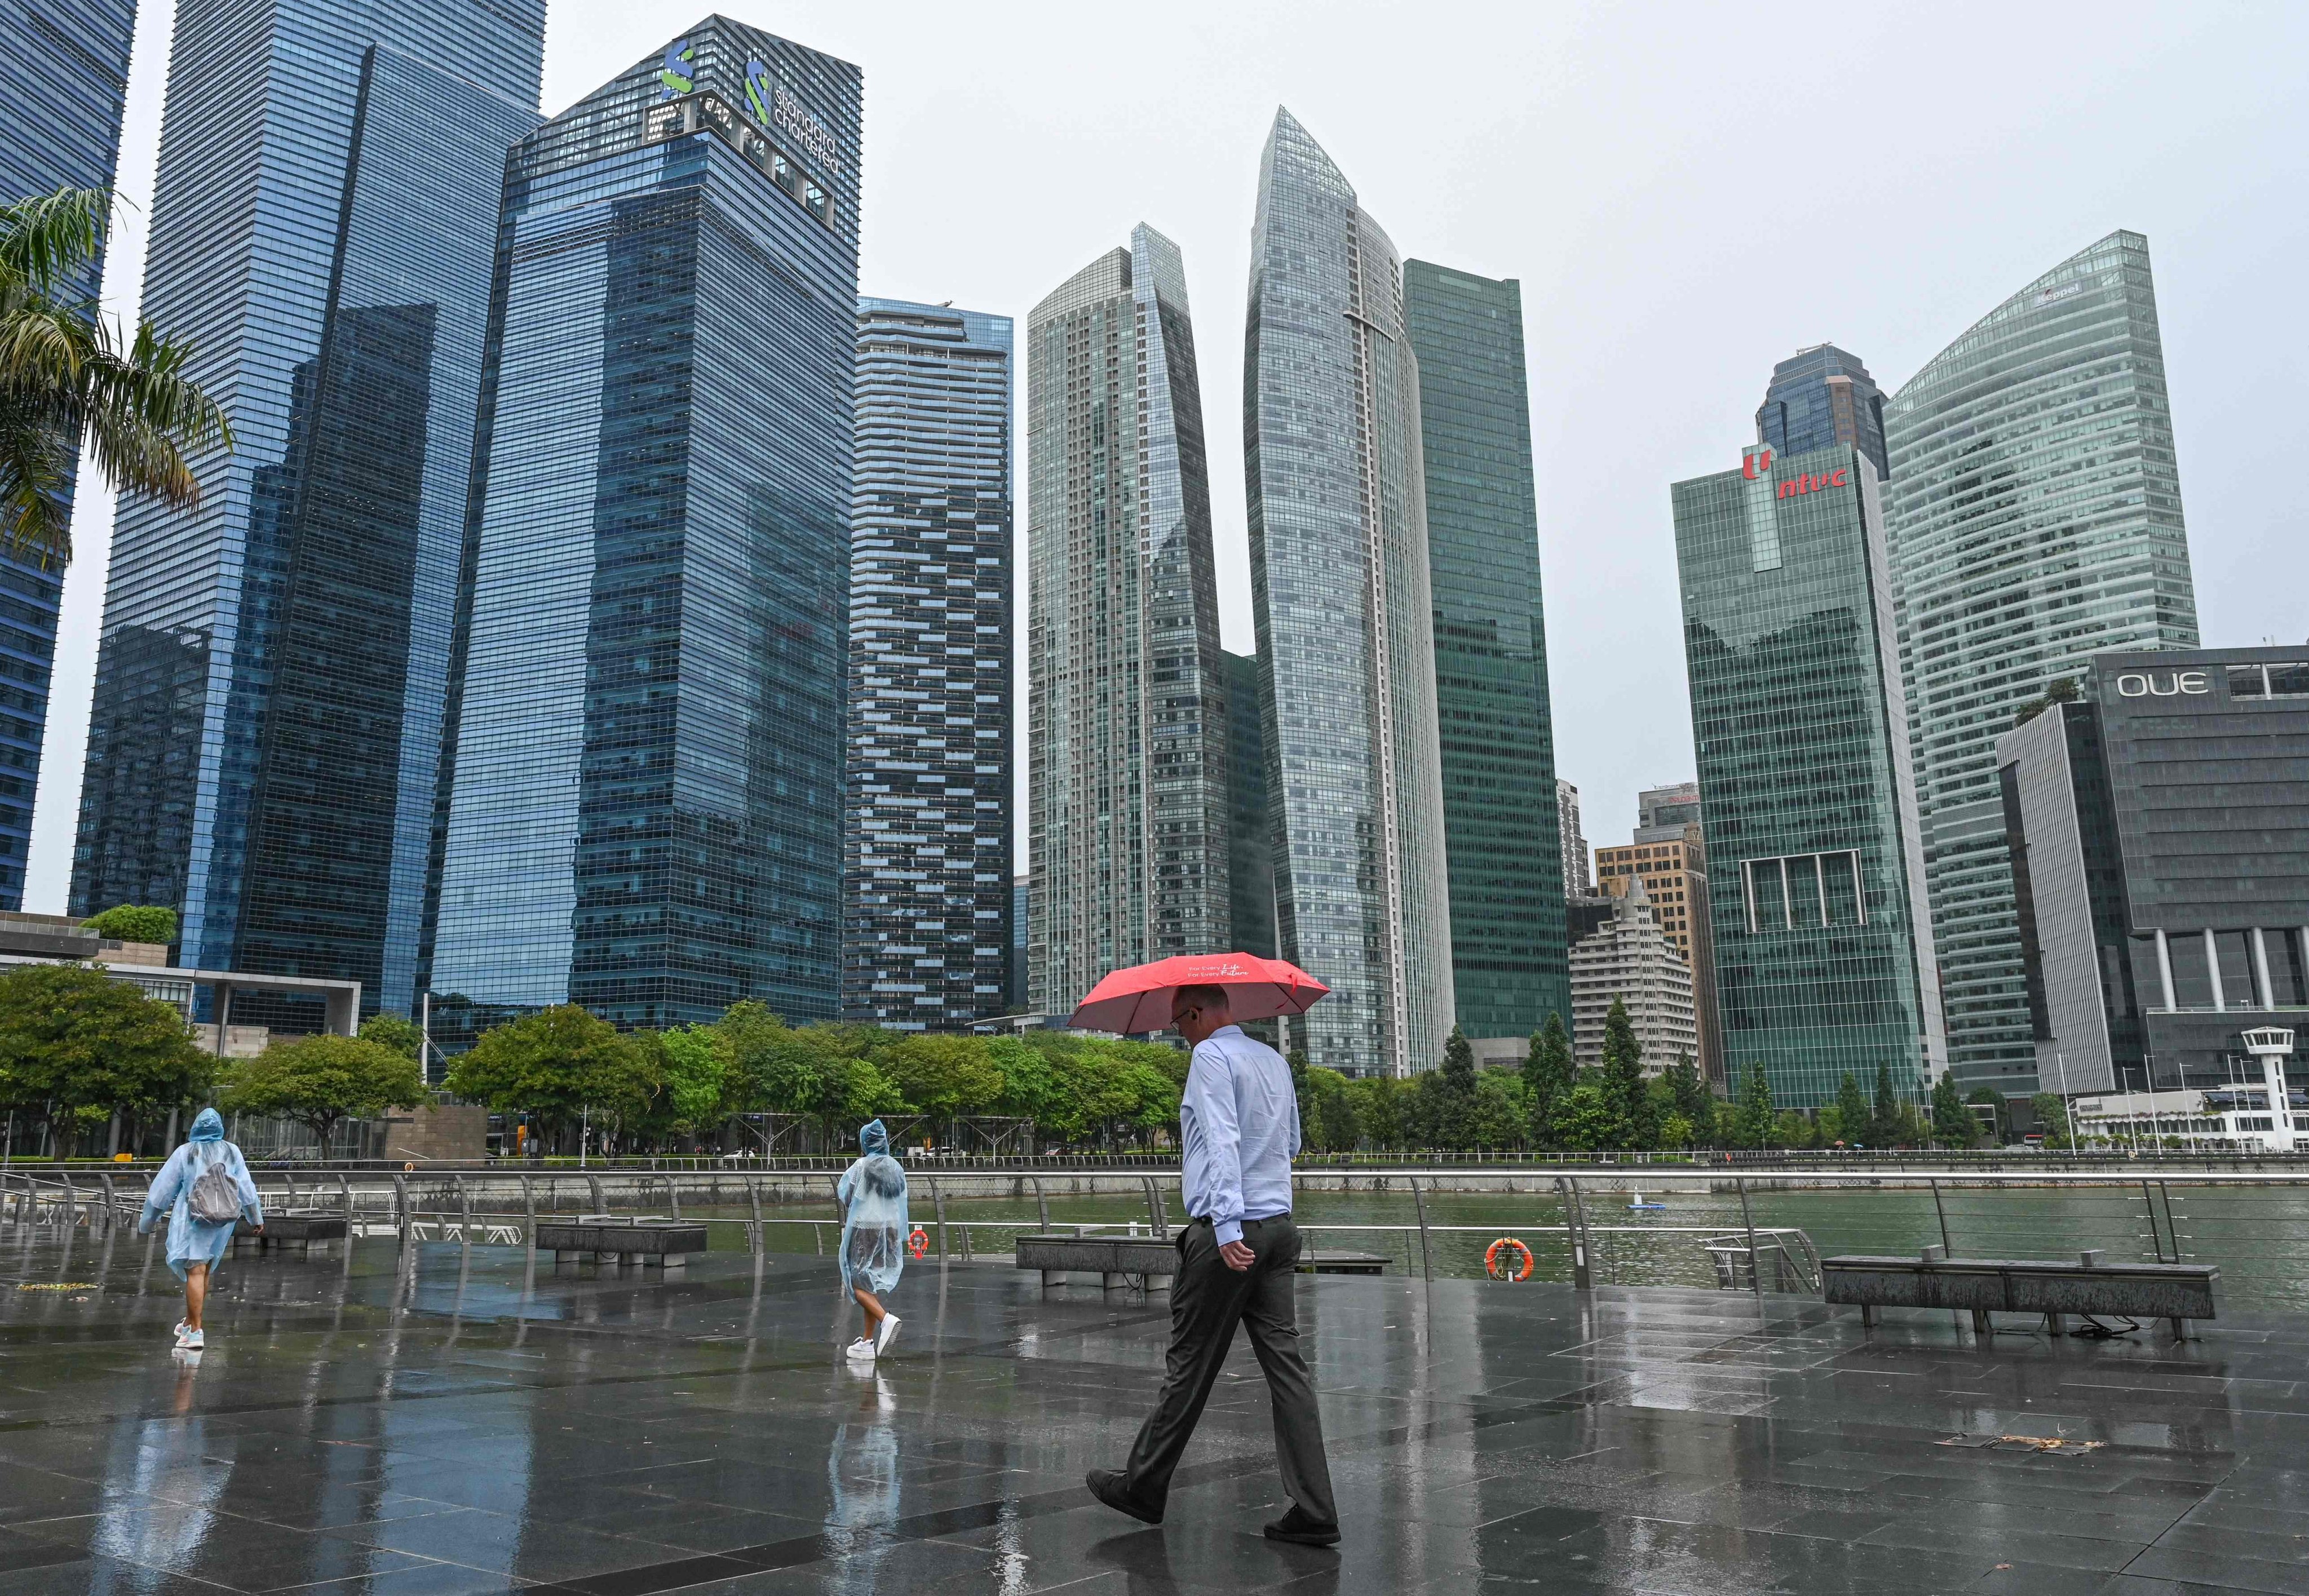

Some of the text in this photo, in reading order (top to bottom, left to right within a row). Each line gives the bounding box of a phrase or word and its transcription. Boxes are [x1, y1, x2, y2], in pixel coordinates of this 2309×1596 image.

[775, 90, 835, 154] standard
[775, 108, 838, 175] chartered
[2038, 283, 2079, 303] Keppel
[1778, 469, 1846, 499] ntuc
[2117, 672, 2209, 697] OUE
